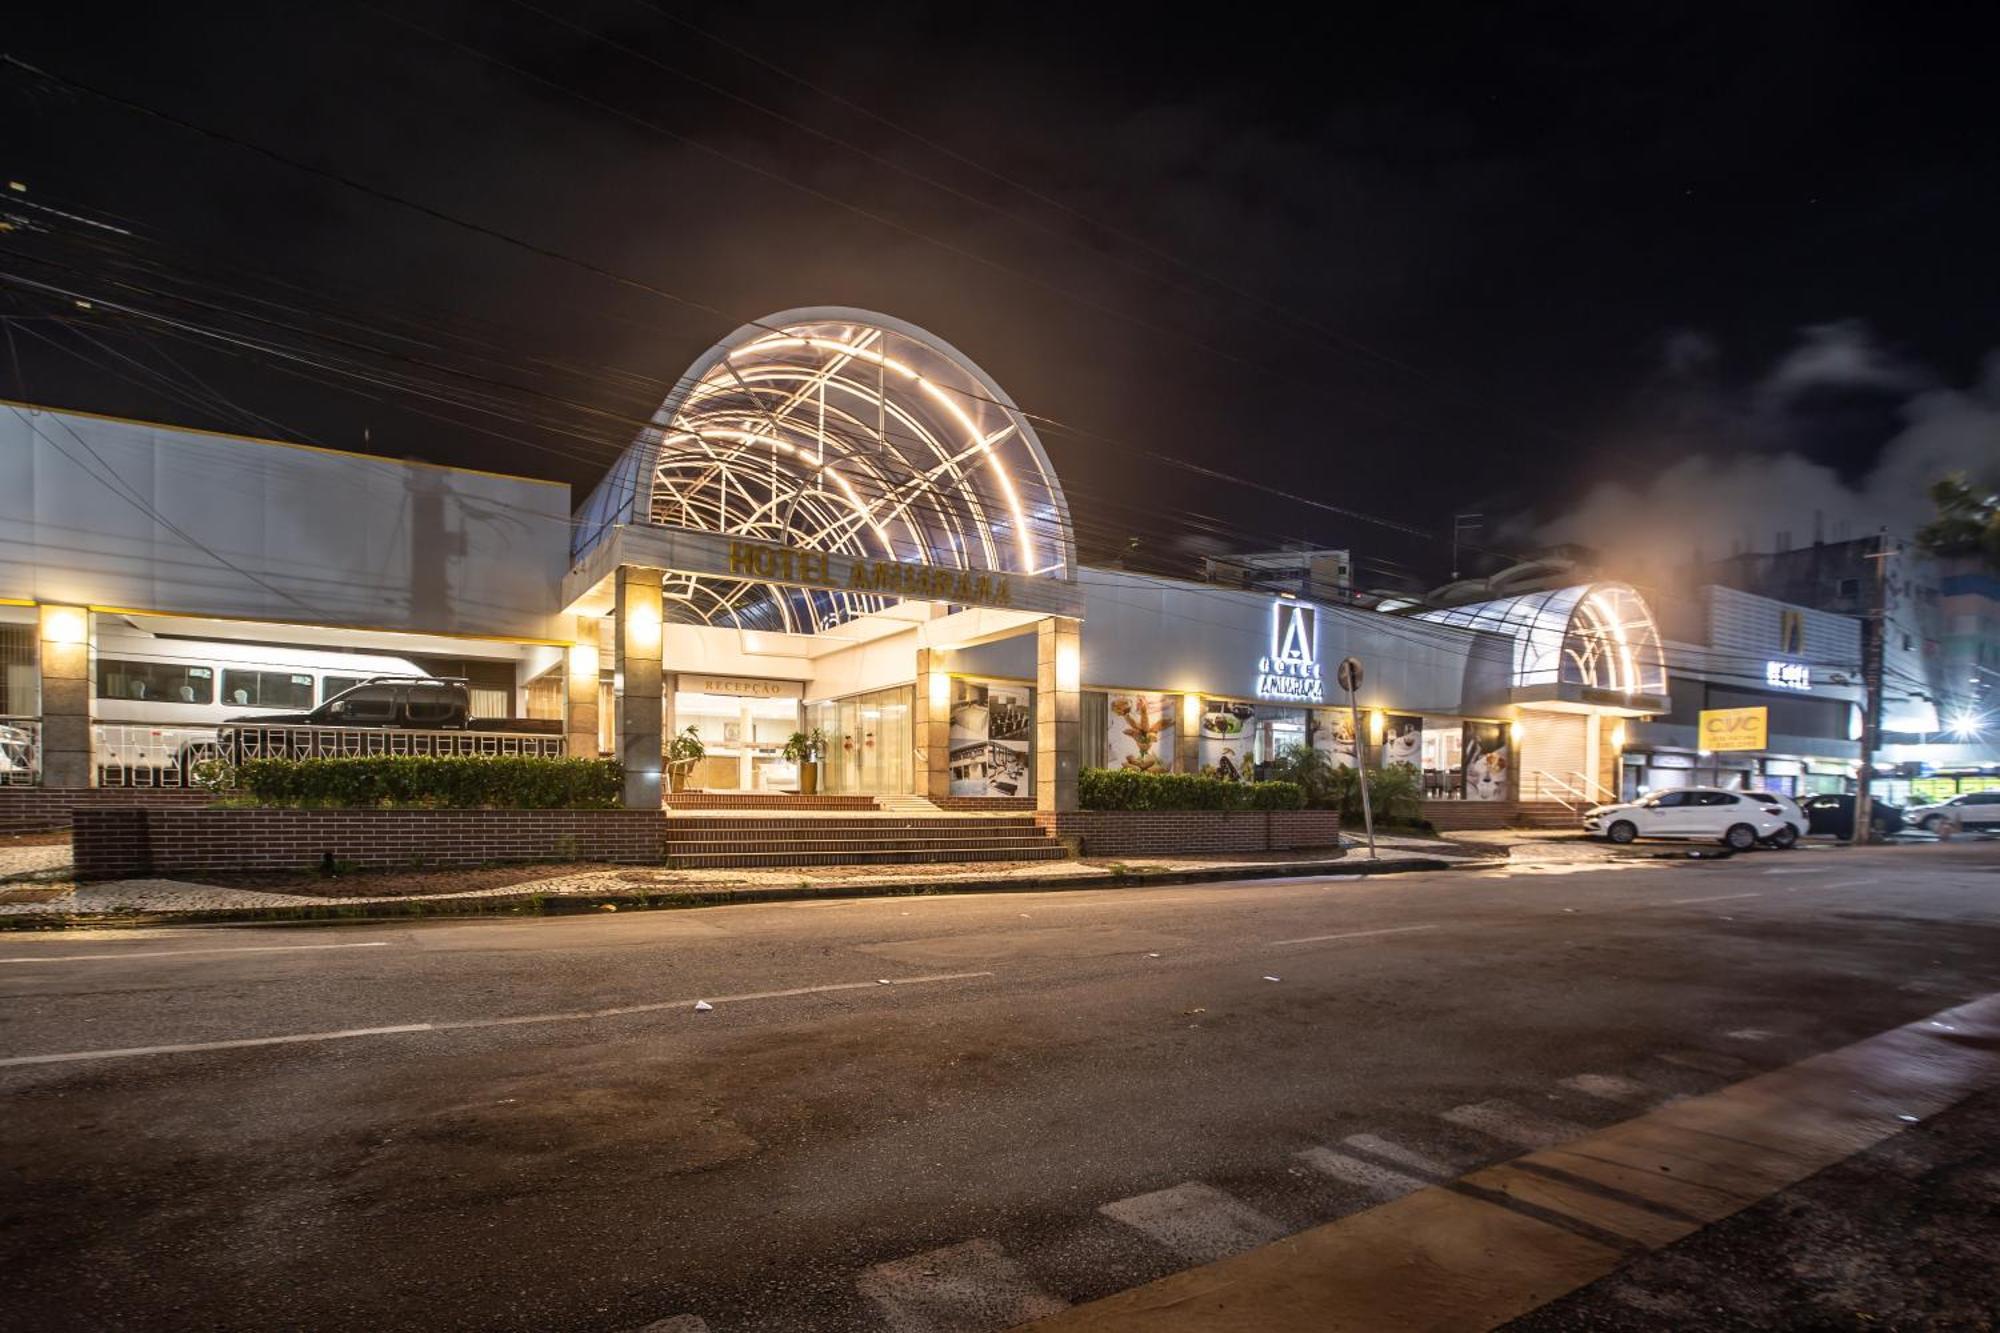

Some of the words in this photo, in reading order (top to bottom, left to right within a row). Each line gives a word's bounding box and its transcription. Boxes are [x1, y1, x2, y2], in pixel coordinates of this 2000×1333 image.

[729, 541, 837, 586] HOTEL
[1259, 656, 1323, 678] HOTEL
[704, 680, 781, 694] RECEPÇÃO
[1706, 716, 1761, 733] CVC
